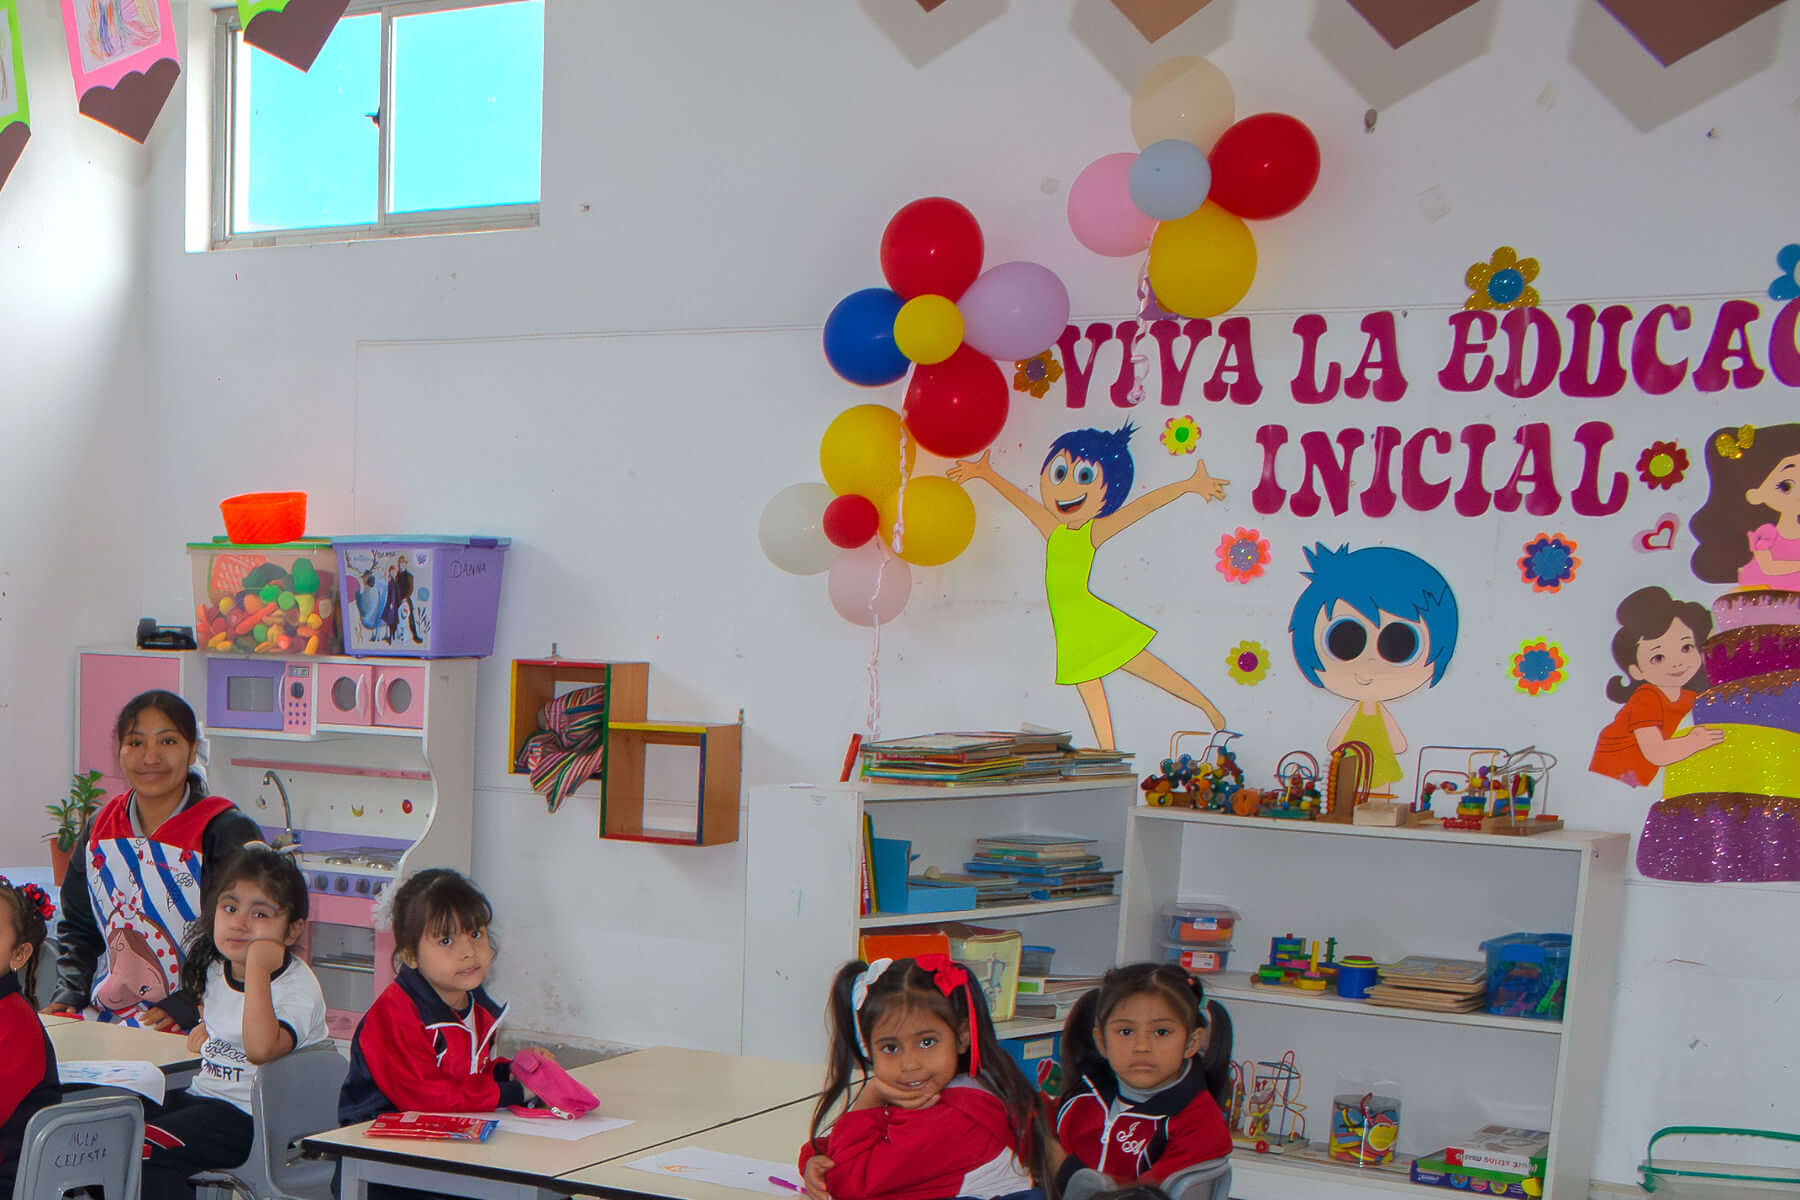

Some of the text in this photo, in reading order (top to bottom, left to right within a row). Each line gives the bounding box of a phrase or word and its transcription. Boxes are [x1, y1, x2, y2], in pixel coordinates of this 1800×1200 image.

[1055, 316, 1263, 409] VIVA
[1290, 311, 1408, 404] LA
[1251, 420, 1630, 518] INICIAL
